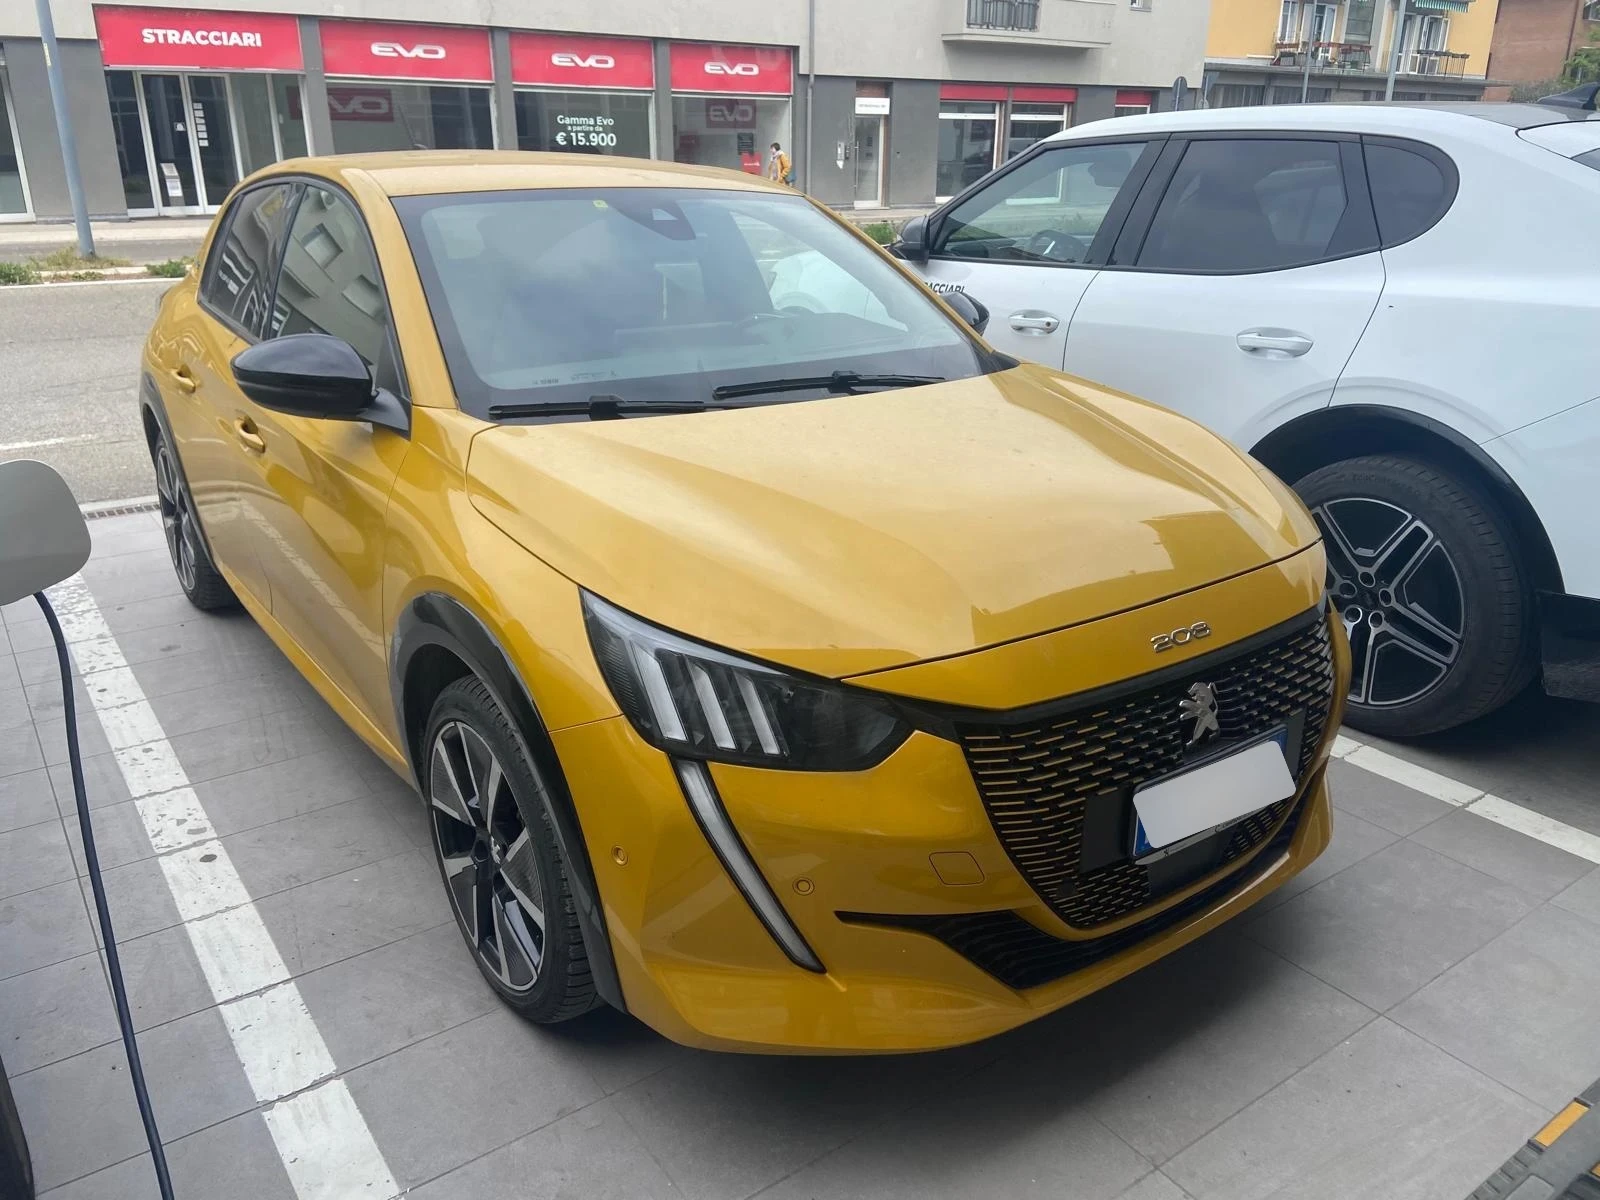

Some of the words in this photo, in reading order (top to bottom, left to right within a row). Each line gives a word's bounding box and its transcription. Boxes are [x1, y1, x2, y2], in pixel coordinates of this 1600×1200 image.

[141, 28, 262, 47] STRACCIARI
[371, 42, 446, 59] EVO
[551, 53, 615, 69] EVO
[704, 61, 759, 76] EVO
[328, 95, 390, 114] VO
[556, 114, 595, 125] Gamma
[596, 116, 615, 126] Evo
[710, 105, 753, 122] EVO
[555, 132, 567, 146] €
[570, 132, 617, 147] 15.900
[924, 281, 965, 294] ACCIARI
[1150, 621, 1210, 653] 208
